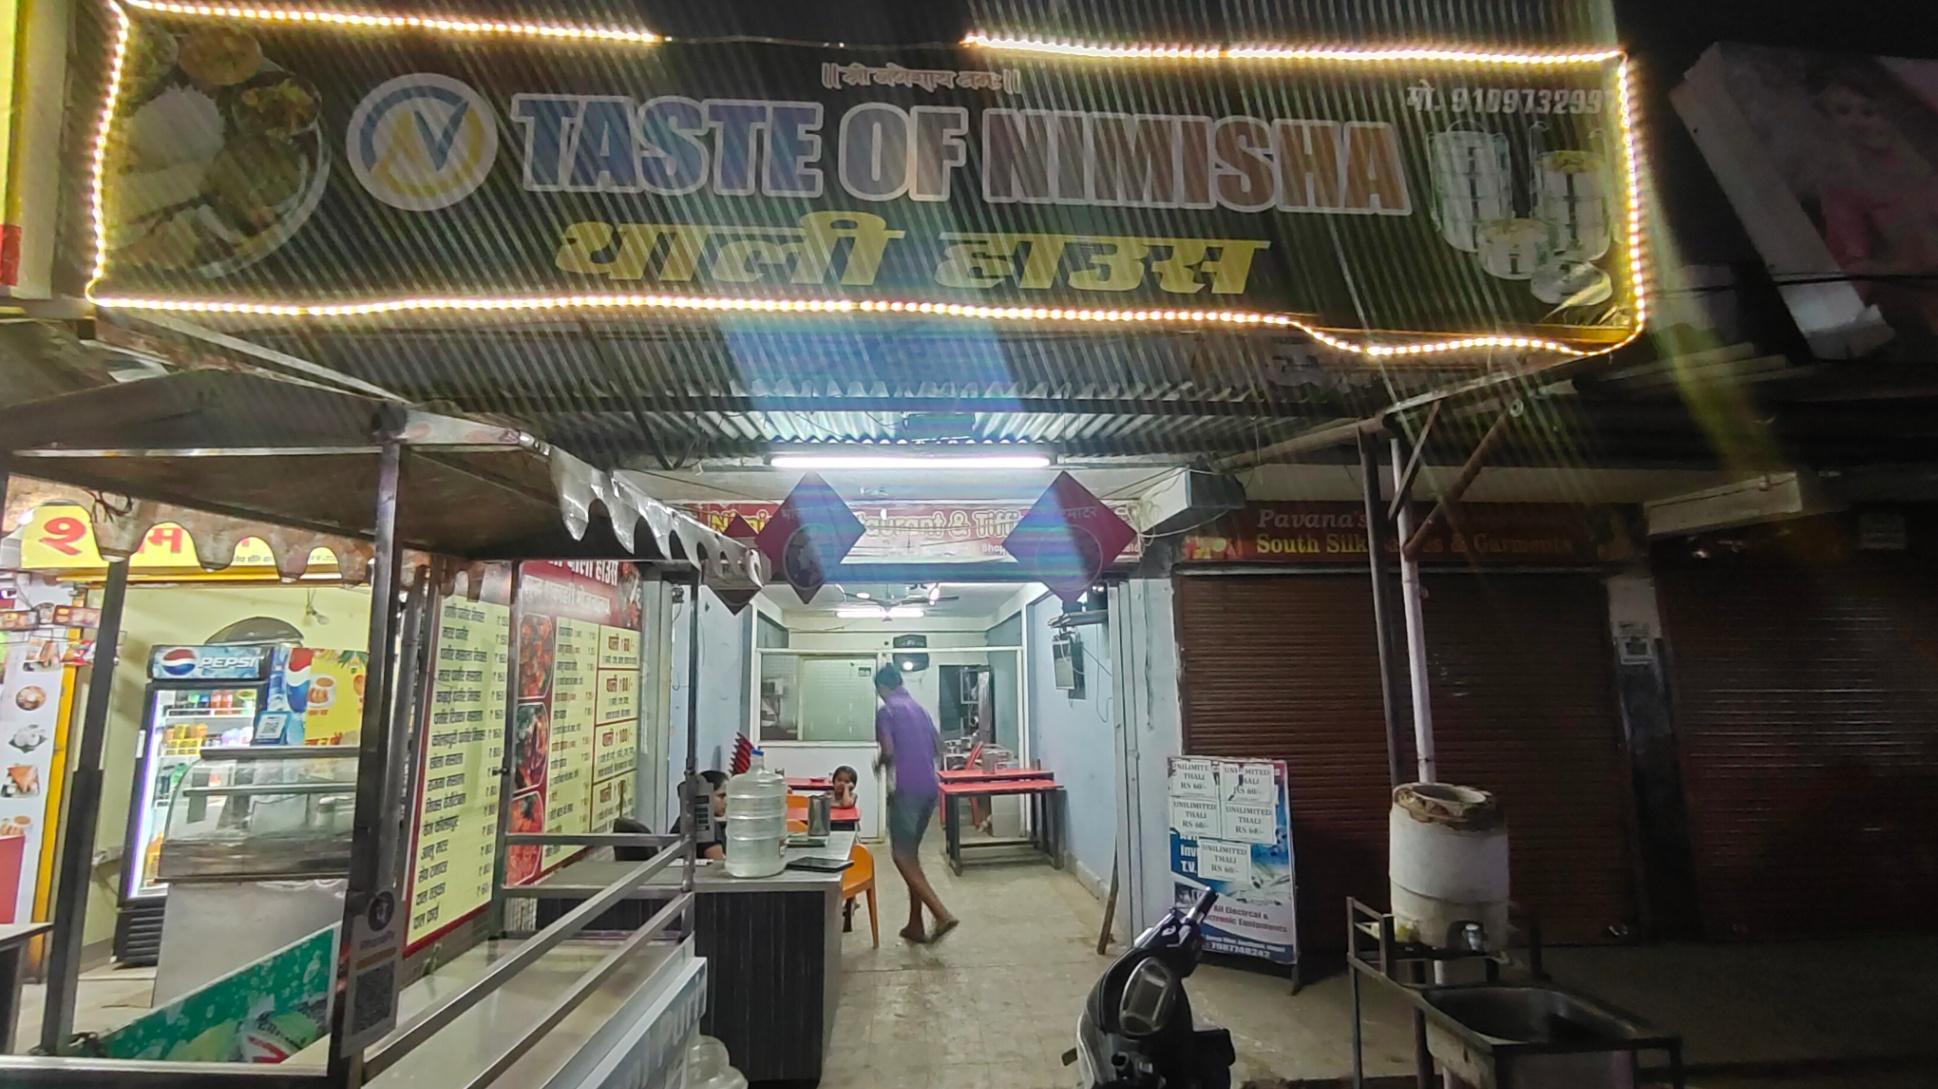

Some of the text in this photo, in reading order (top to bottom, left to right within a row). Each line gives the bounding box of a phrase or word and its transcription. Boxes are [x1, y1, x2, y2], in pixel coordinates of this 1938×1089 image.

[510, 92, 1412, 216] TASTE OF NIMISHA
[555, 210, 1271, 294] थाली हाउस
[973, 510, 1021, 538] Tiffi
[1256, 509, 1369, 529] Pavana's
[1256, 533, 1321, 554] South
[1325, 533, 1370, 554] Silk
[198, 656, 260, 670] PEPSI
